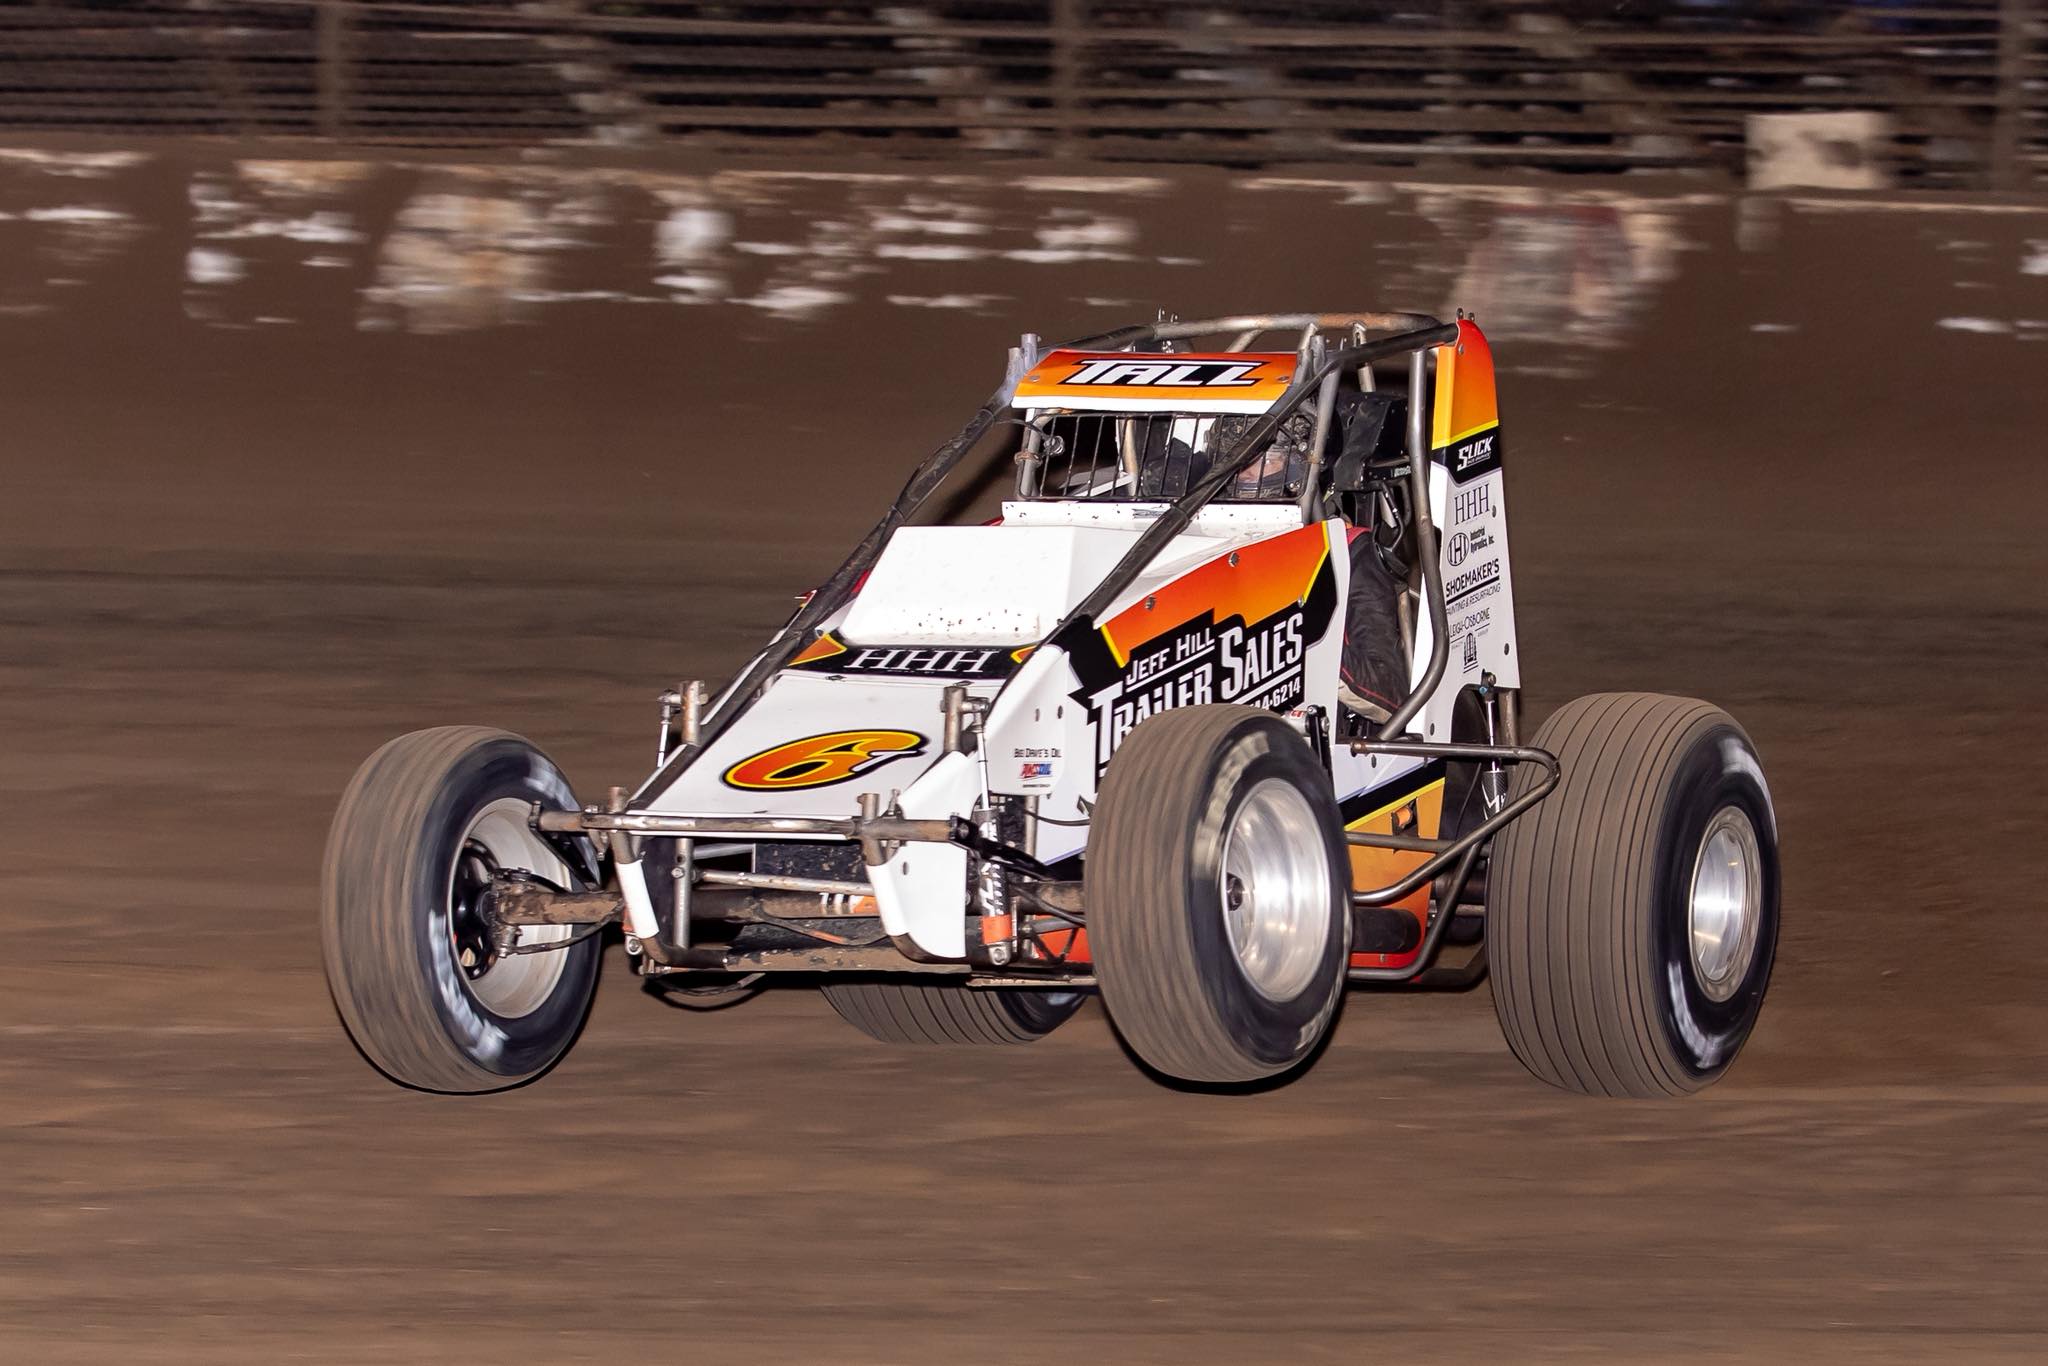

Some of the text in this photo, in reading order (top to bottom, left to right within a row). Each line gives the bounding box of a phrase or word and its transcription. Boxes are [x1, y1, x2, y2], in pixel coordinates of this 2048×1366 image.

[1058, 359, 1271, 387] TALL
[1457, 435, 1494, 471] SLICK
[1454, 483, 1490, 526] HHH
[1446, 558, 1500, 598] SHOEMAKER'S
[843, 648, 1000, 673] HHH
[1126, 627, 1216, 686] JEFF HILL
[1218, 612, 1304, 700] SALES
